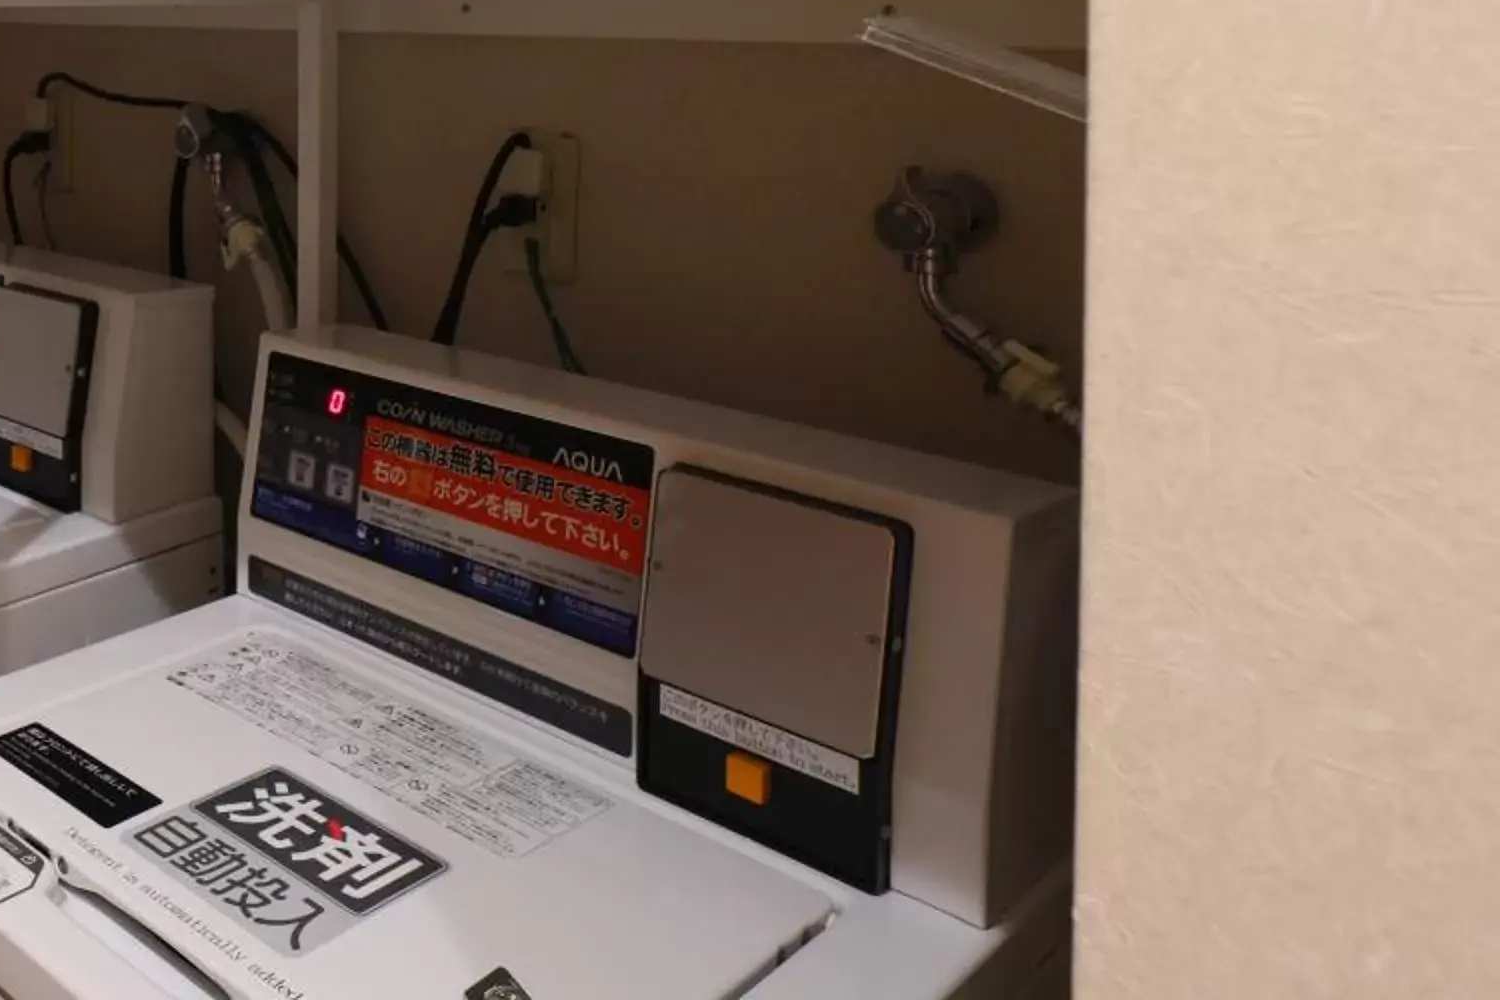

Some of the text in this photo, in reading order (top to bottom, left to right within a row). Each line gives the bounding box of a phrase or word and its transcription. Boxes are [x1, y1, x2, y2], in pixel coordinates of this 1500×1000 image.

[328, 388, 345, 414] 0
[553, 447, 622, 482] AQUA
[216, 782, 423, 899] 洗剤
[134, 816, 325, 951] 自動投入
